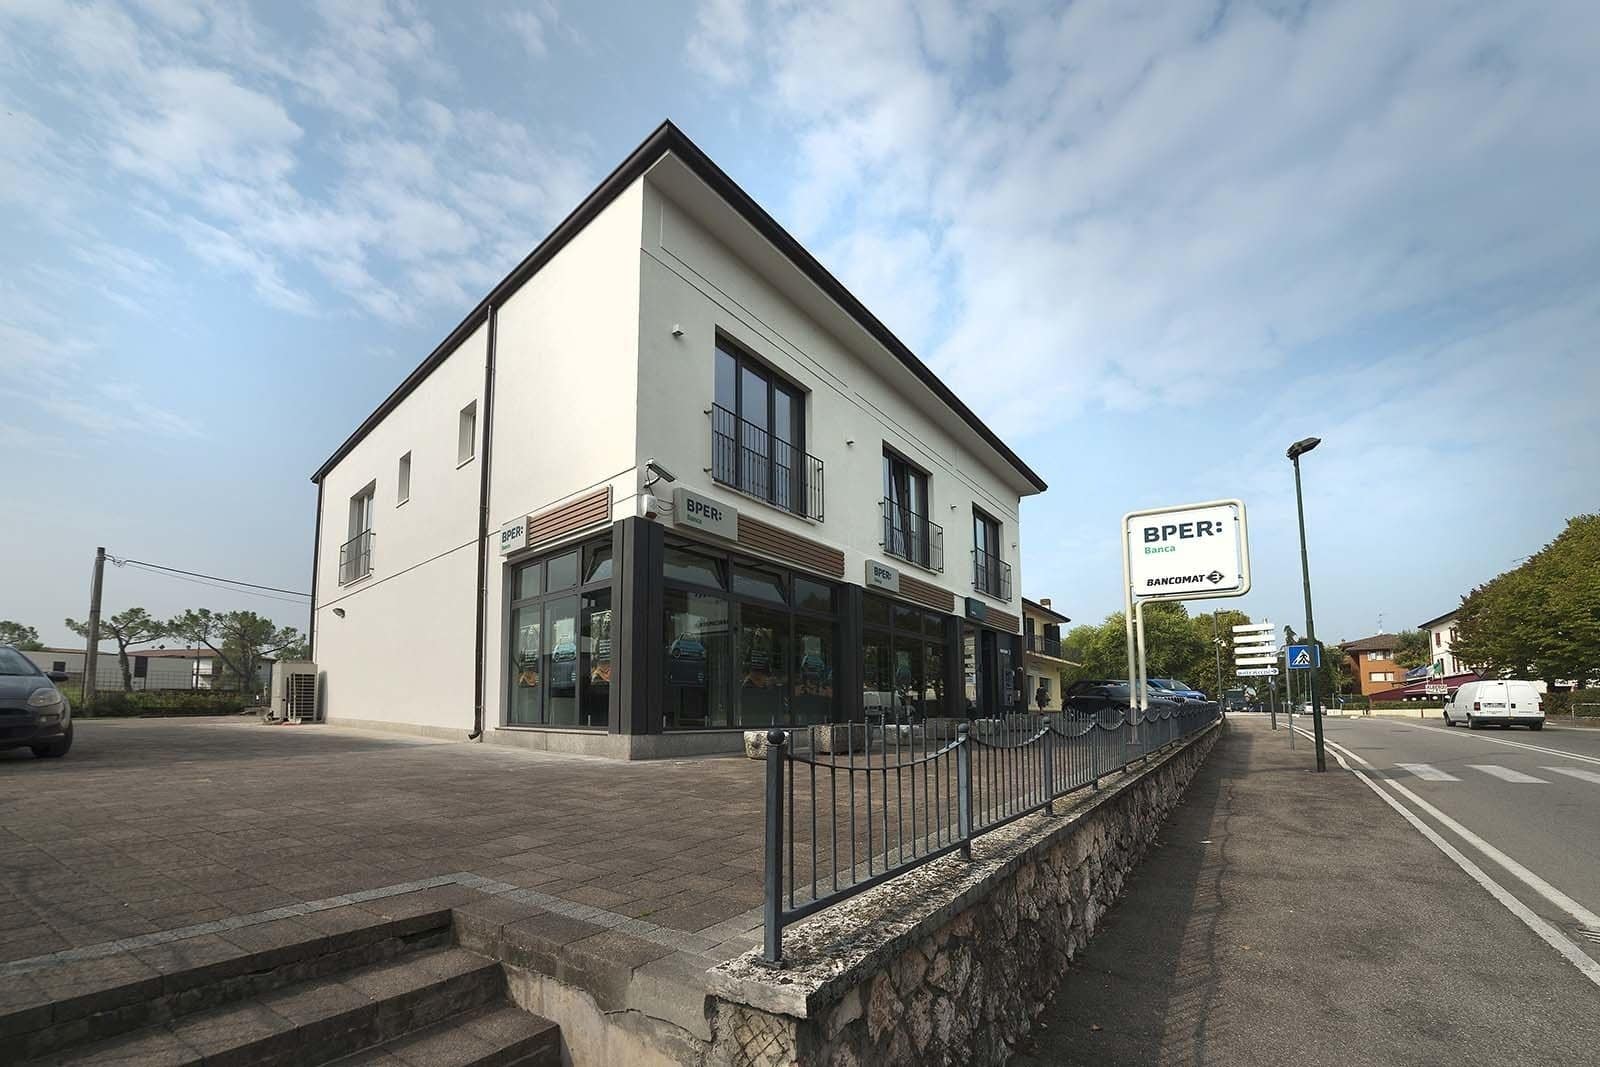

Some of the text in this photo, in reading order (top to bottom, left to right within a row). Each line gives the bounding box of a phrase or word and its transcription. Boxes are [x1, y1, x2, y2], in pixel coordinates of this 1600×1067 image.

[687, 498, 722, 521] BPER:
[502, 525, 524, 543] BPER:
[1144, 520, 1223, 543] BPER:
[1144, 545, 1176, 555] Banca
[1146, 574, 1205, 587] BANCOMAT
